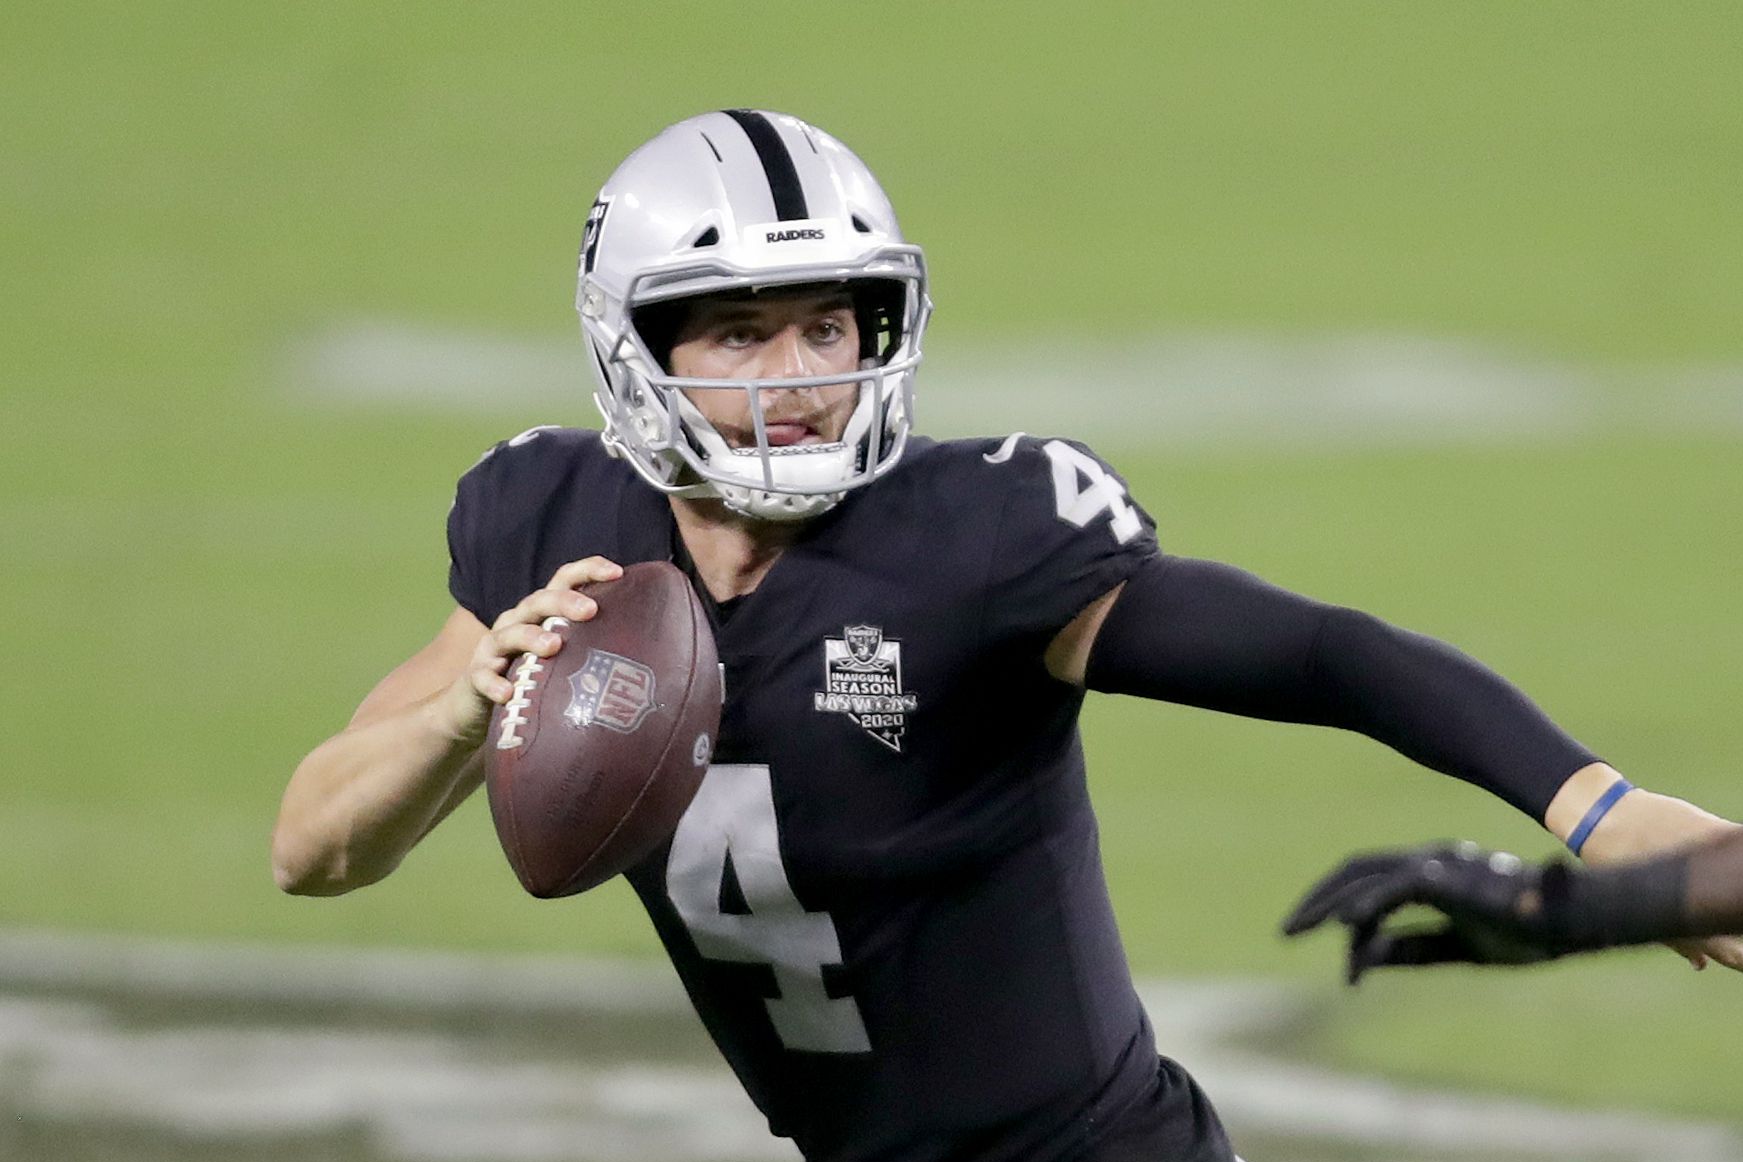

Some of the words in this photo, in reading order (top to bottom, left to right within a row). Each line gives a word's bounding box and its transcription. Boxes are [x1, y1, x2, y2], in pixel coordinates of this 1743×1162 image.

[766, 229, 825, 243] RAIDERS
[1042, 439, 1143, 545] 4
[831, 672, 895, 683] INAUGURAL
[831, 681, 896, 695] SEASON
[599, 671, 646, 725] NFL
[861, 713, 904, 728] 2020
[665, 763, 873, 1052] 4
